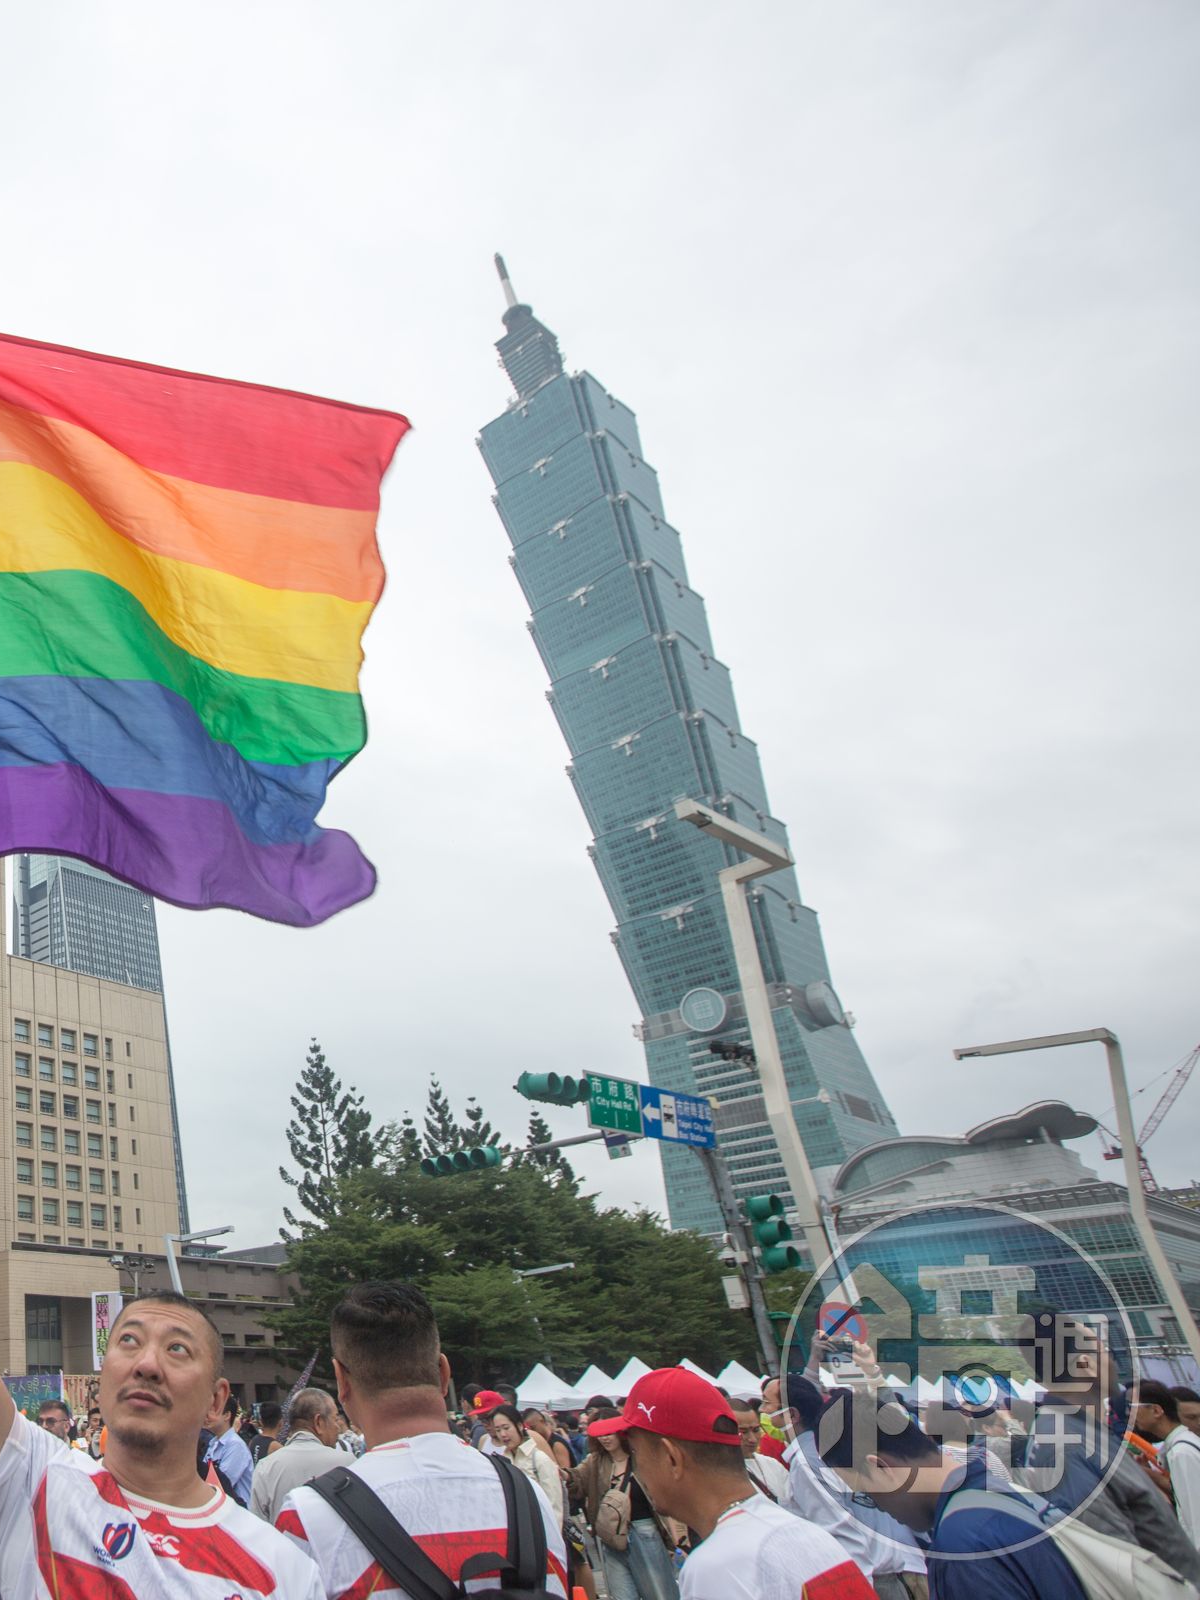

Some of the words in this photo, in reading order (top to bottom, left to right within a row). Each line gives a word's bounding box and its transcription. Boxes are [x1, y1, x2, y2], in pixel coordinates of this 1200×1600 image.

[590, 1077, 635, 1100] 市府路
[596, 1096, 610, 1109] City
[611, 1099, 623, 1110] Hall
